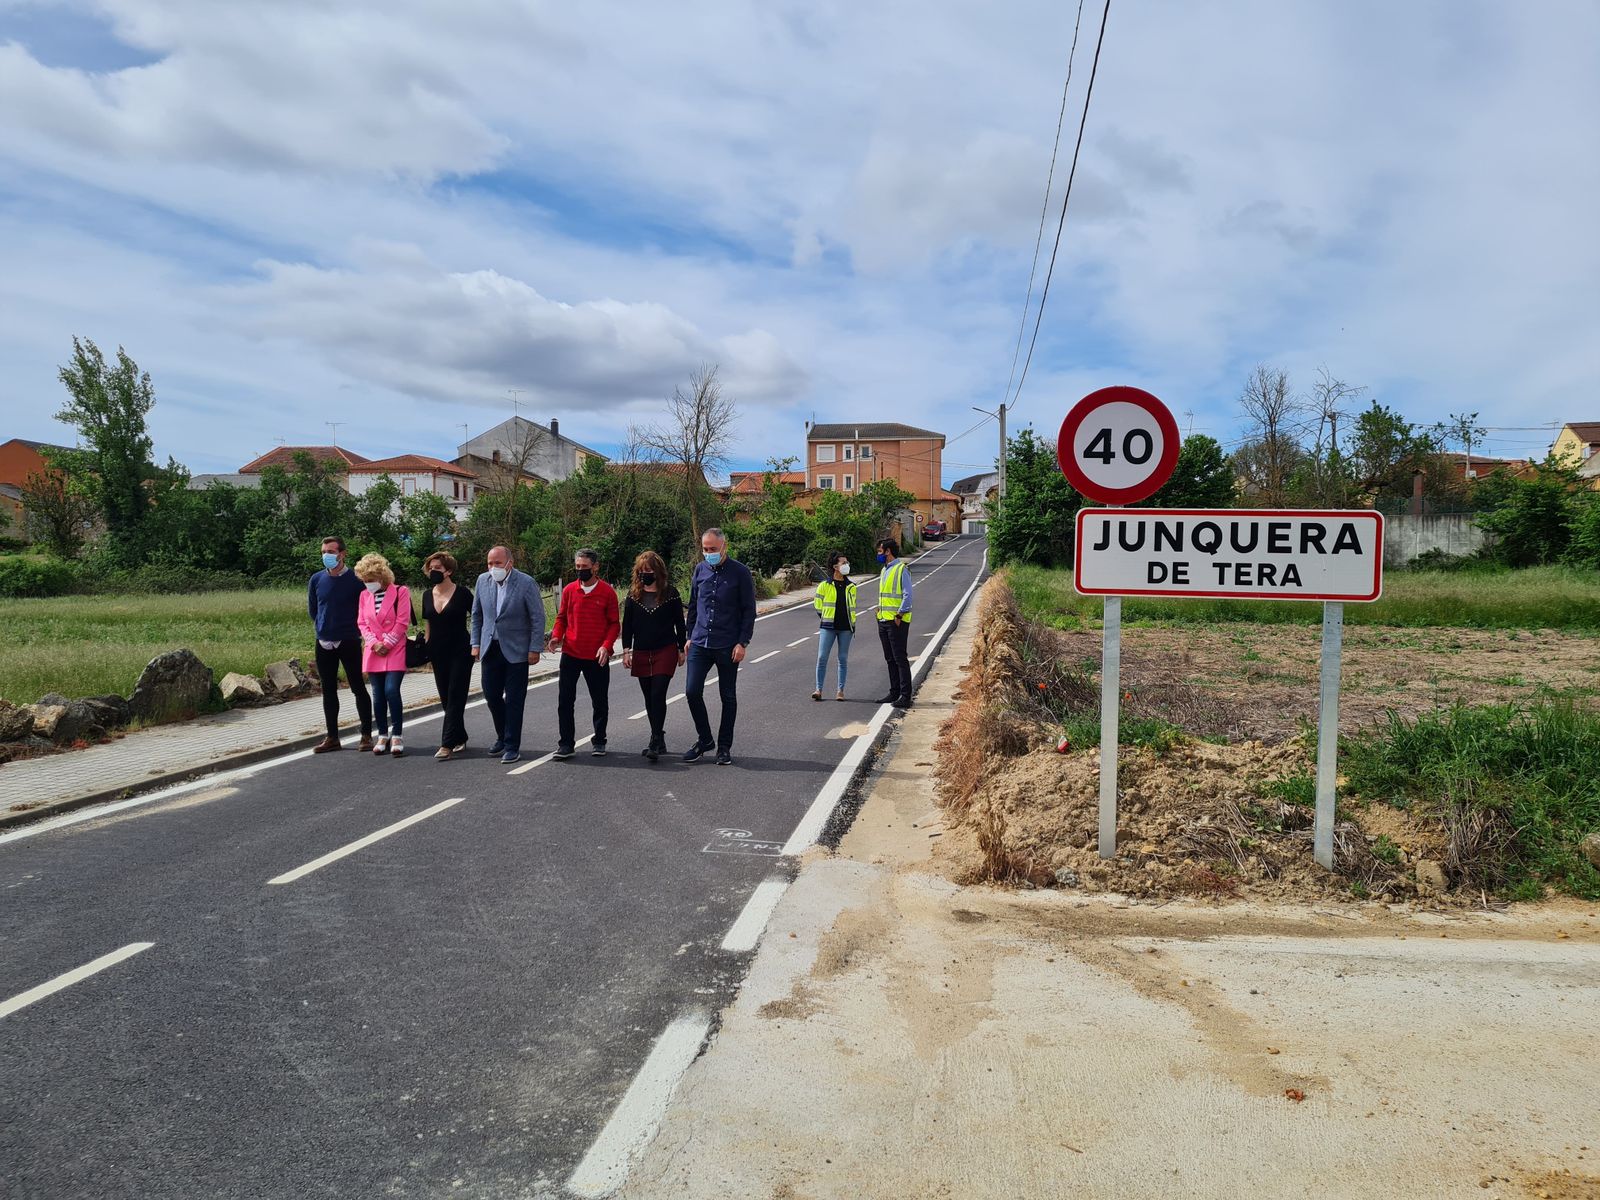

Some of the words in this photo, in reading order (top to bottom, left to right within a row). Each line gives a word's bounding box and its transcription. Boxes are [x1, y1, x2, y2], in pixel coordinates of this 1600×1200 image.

[1083, 428, 1153, 464] 40
[1094, 521, 1363, 555] JUNQUERA
[1148, 562, 1189, 584] DE
[1213, 563, 1302, 586] TERA
